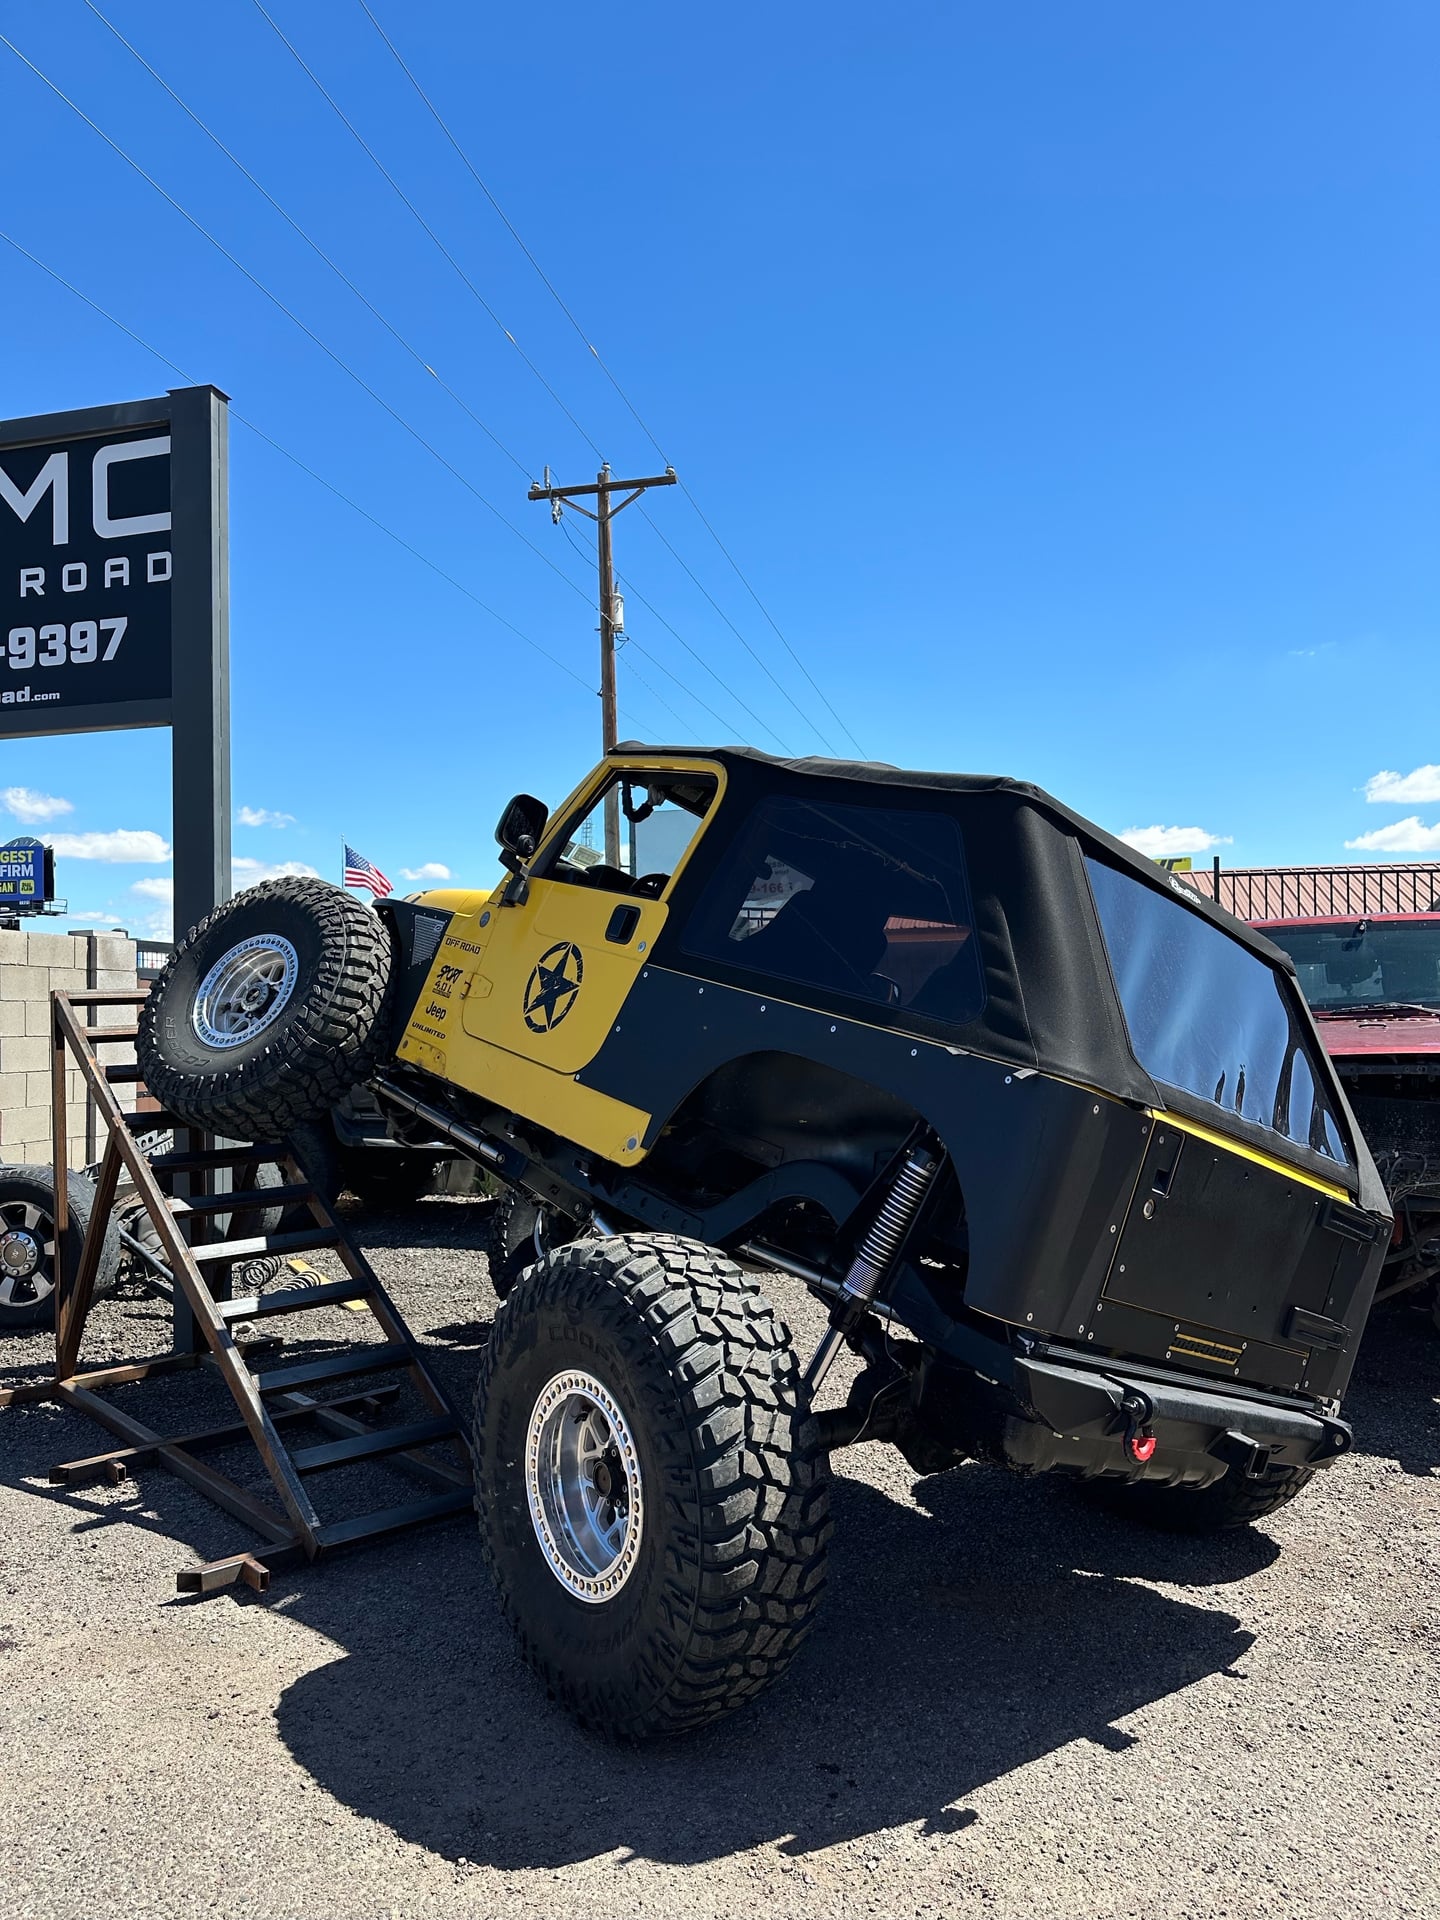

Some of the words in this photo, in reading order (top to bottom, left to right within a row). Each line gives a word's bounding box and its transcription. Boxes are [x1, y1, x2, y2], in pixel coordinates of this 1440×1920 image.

[0, 435, 171, 545] MC
[20, 551, 172, 598] ROAD
[0, 686, 60, 704] ad.com
[0, 864, 34, 877] FIRM
[445, 937, 460, 948] OFF
[460, 941, 481, 955] ROAD
[425, 1000, 447, 1022] Jeep
[411, 1021, 447, 1040] UNLIMITED
